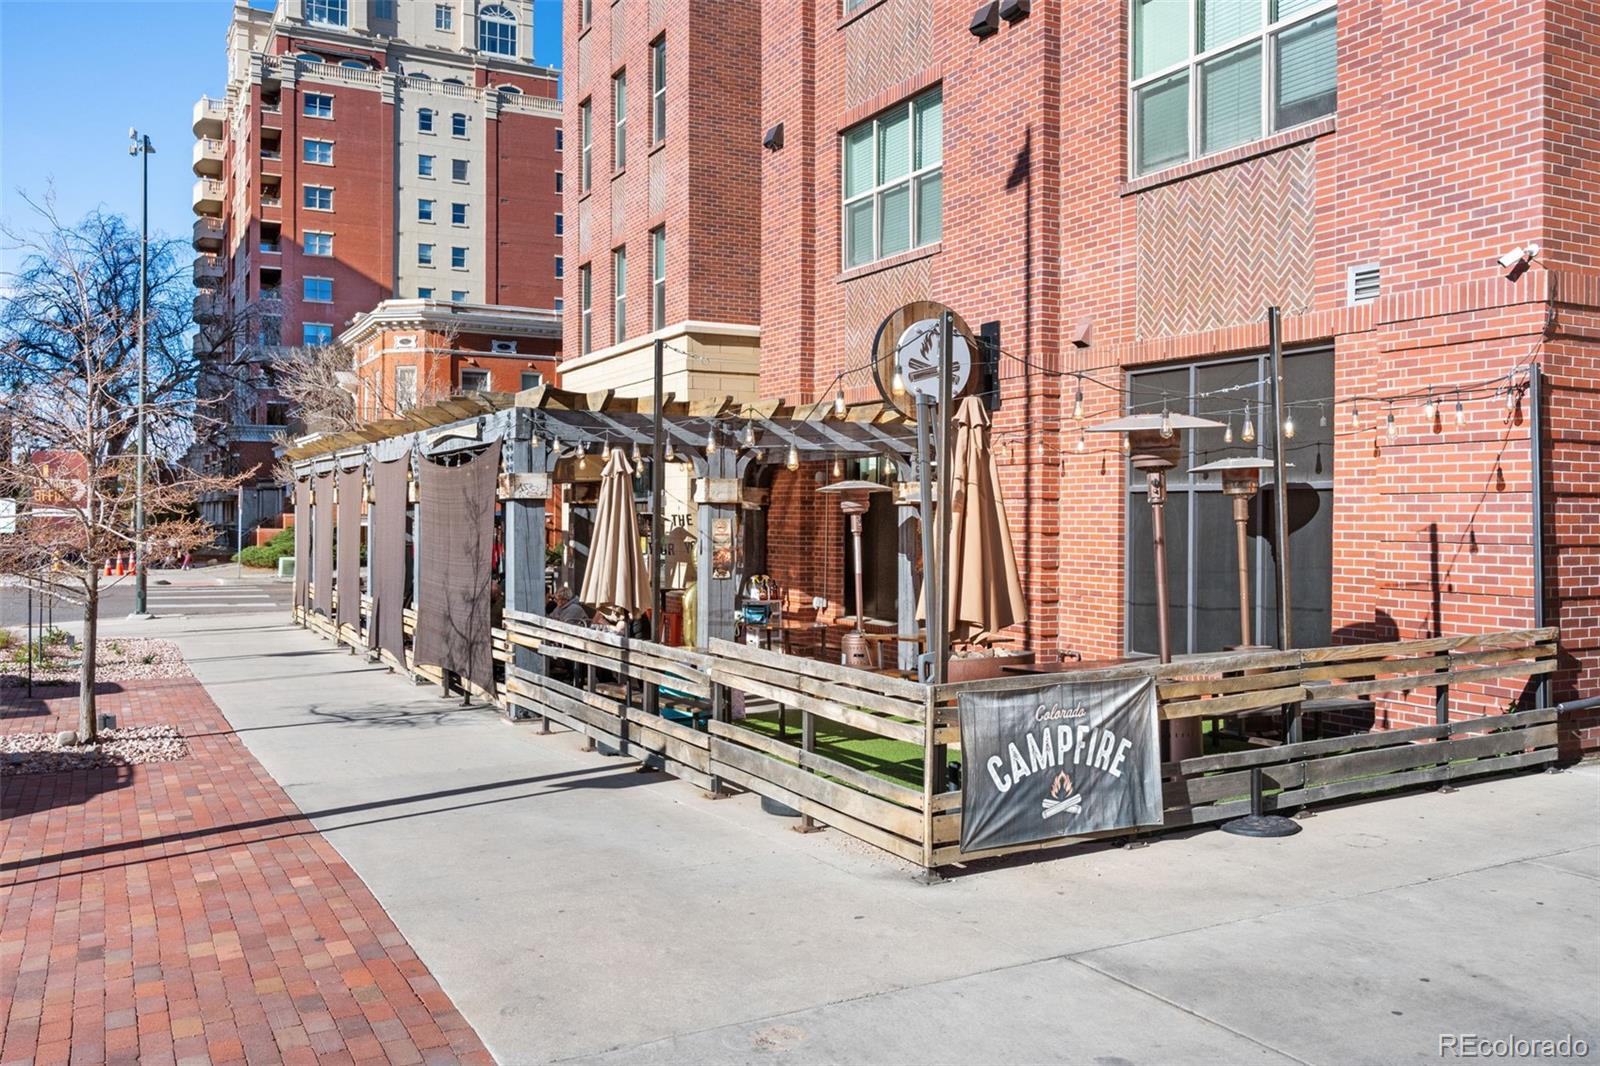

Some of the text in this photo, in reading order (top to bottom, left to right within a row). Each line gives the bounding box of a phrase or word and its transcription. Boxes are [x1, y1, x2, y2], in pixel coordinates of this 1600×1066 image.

[671, 513, 693, 527] THE
[1035, 702, 1086, 722] Colorado
[987, 724, 1133, 793] CAMPFIRE
